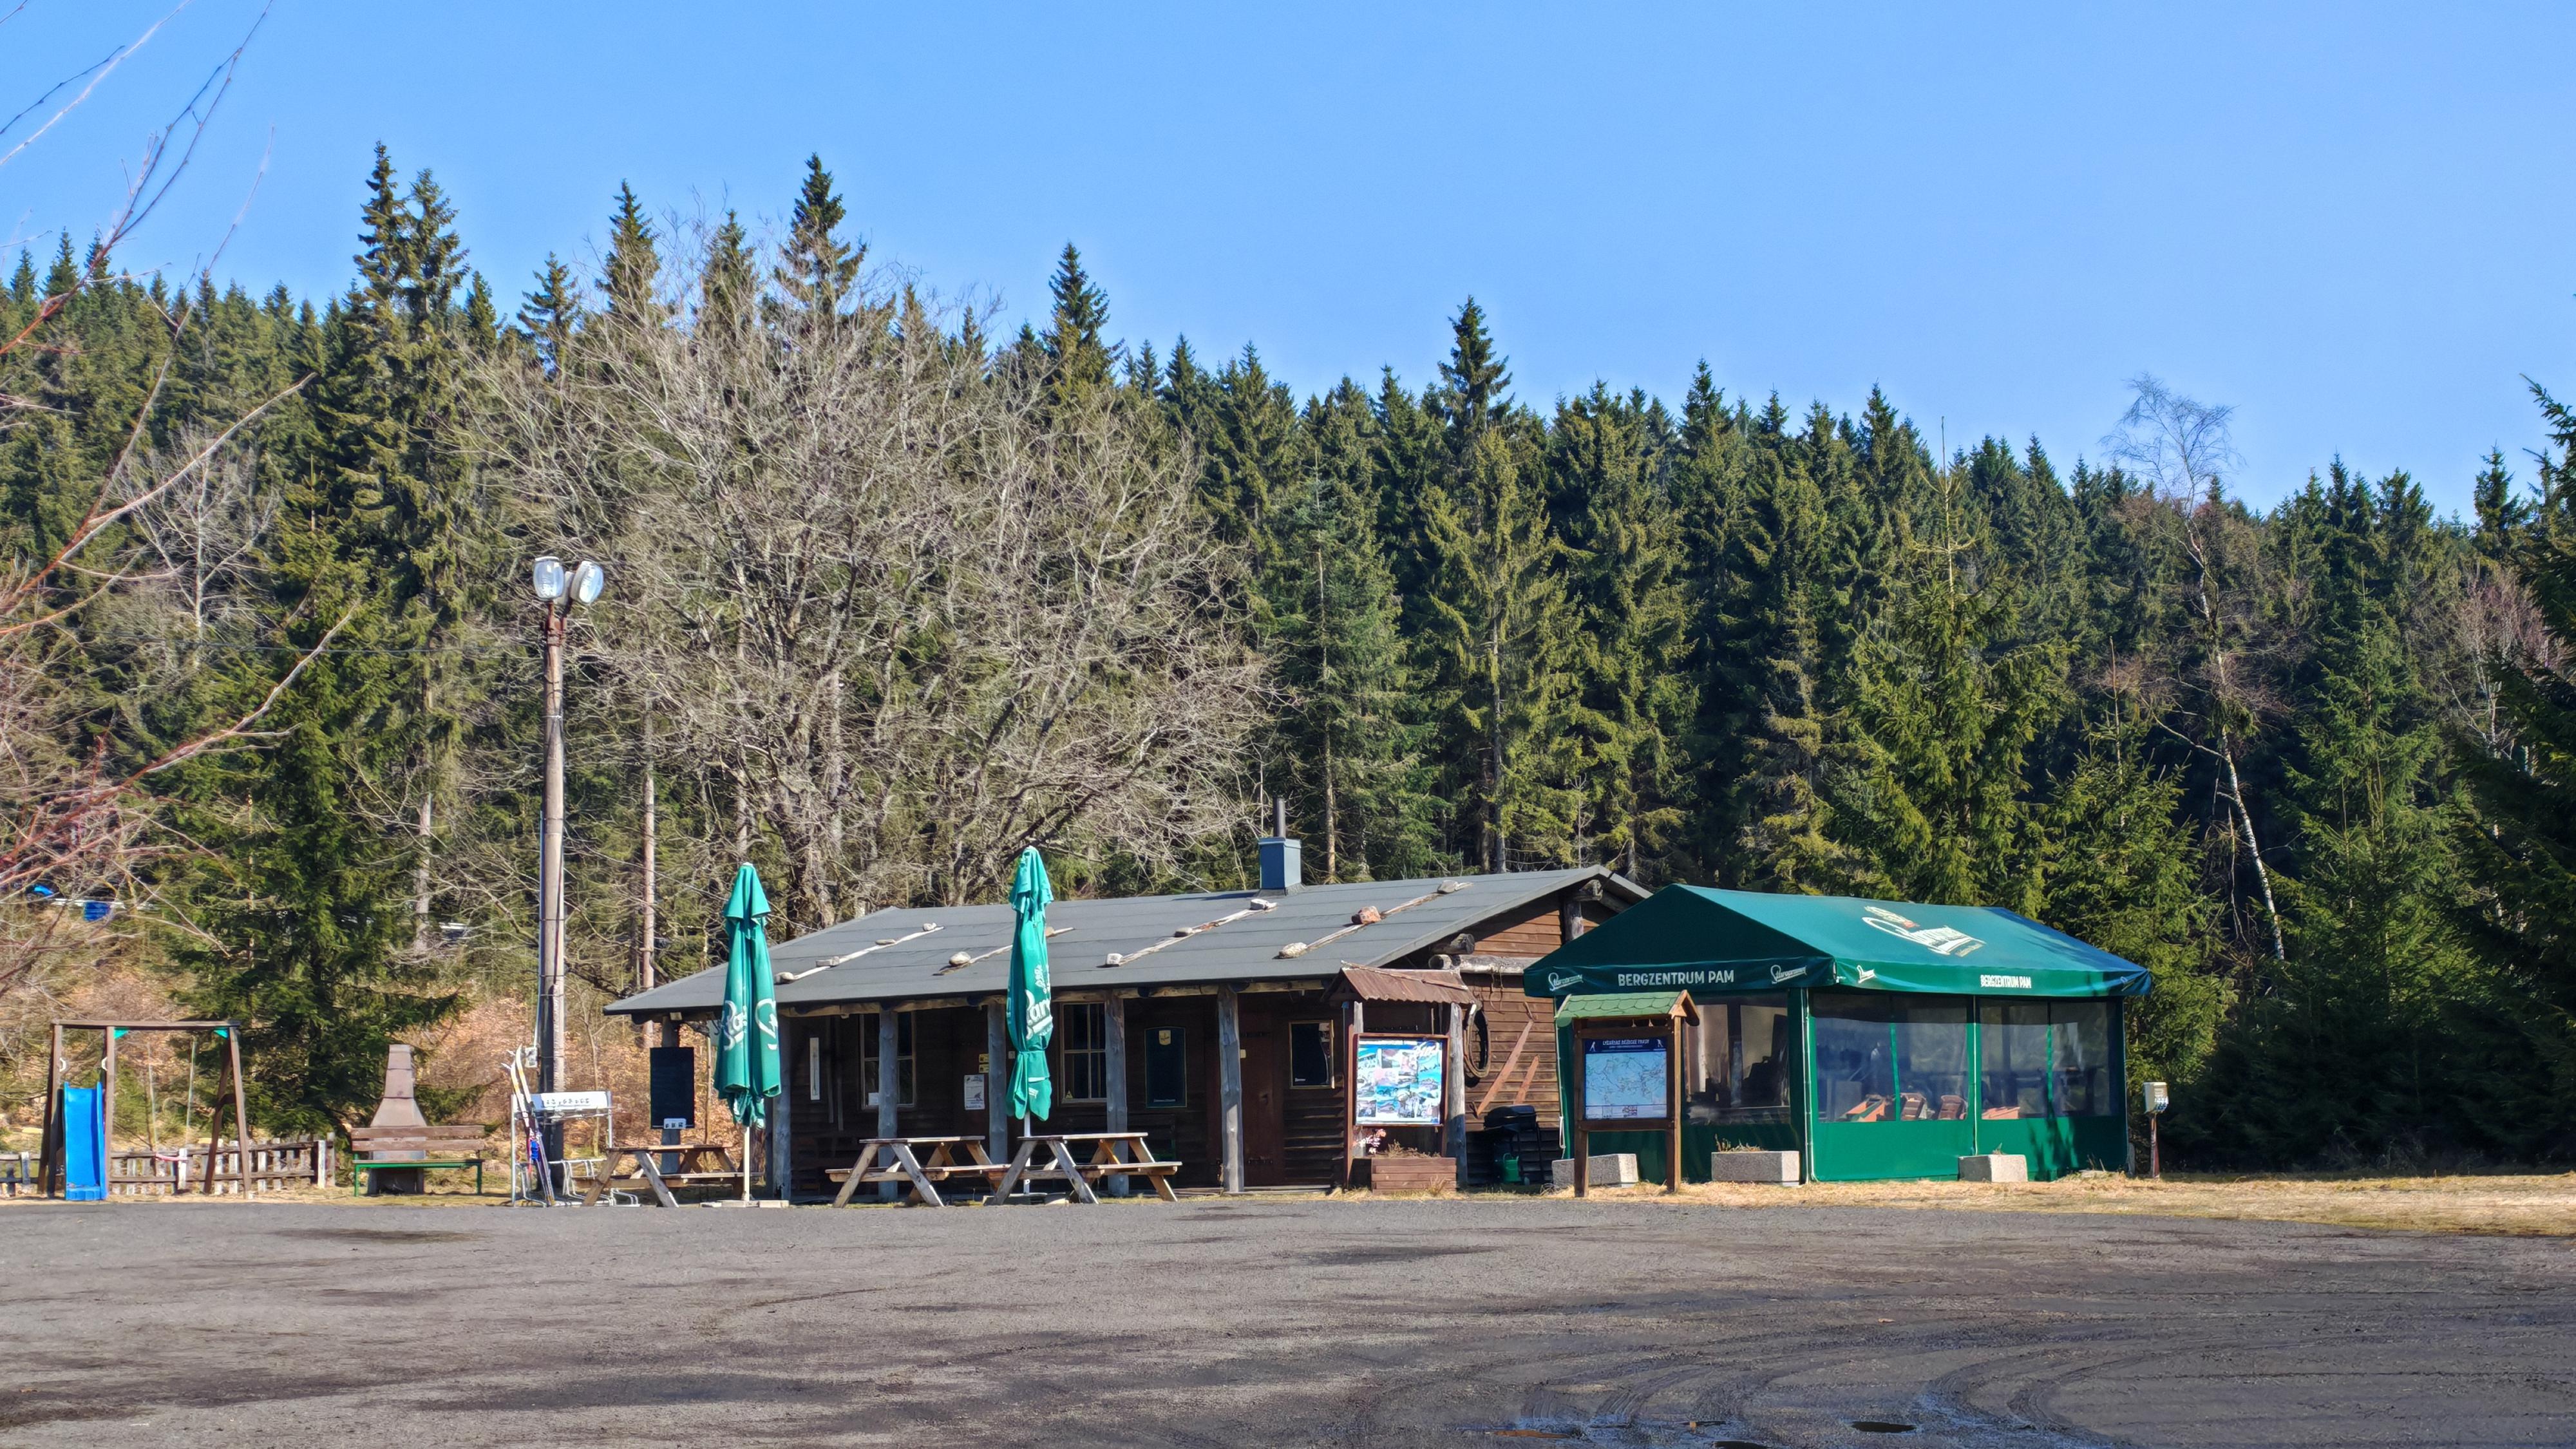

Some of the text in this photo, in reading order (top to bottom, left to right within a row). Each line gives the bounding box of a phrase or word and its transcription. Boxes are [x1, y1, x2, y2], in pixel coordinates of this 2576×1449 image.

[1617, 969, 1735, 987] BERGZENTRUM PAM
[2019, 976, 2032, 989] PAM
